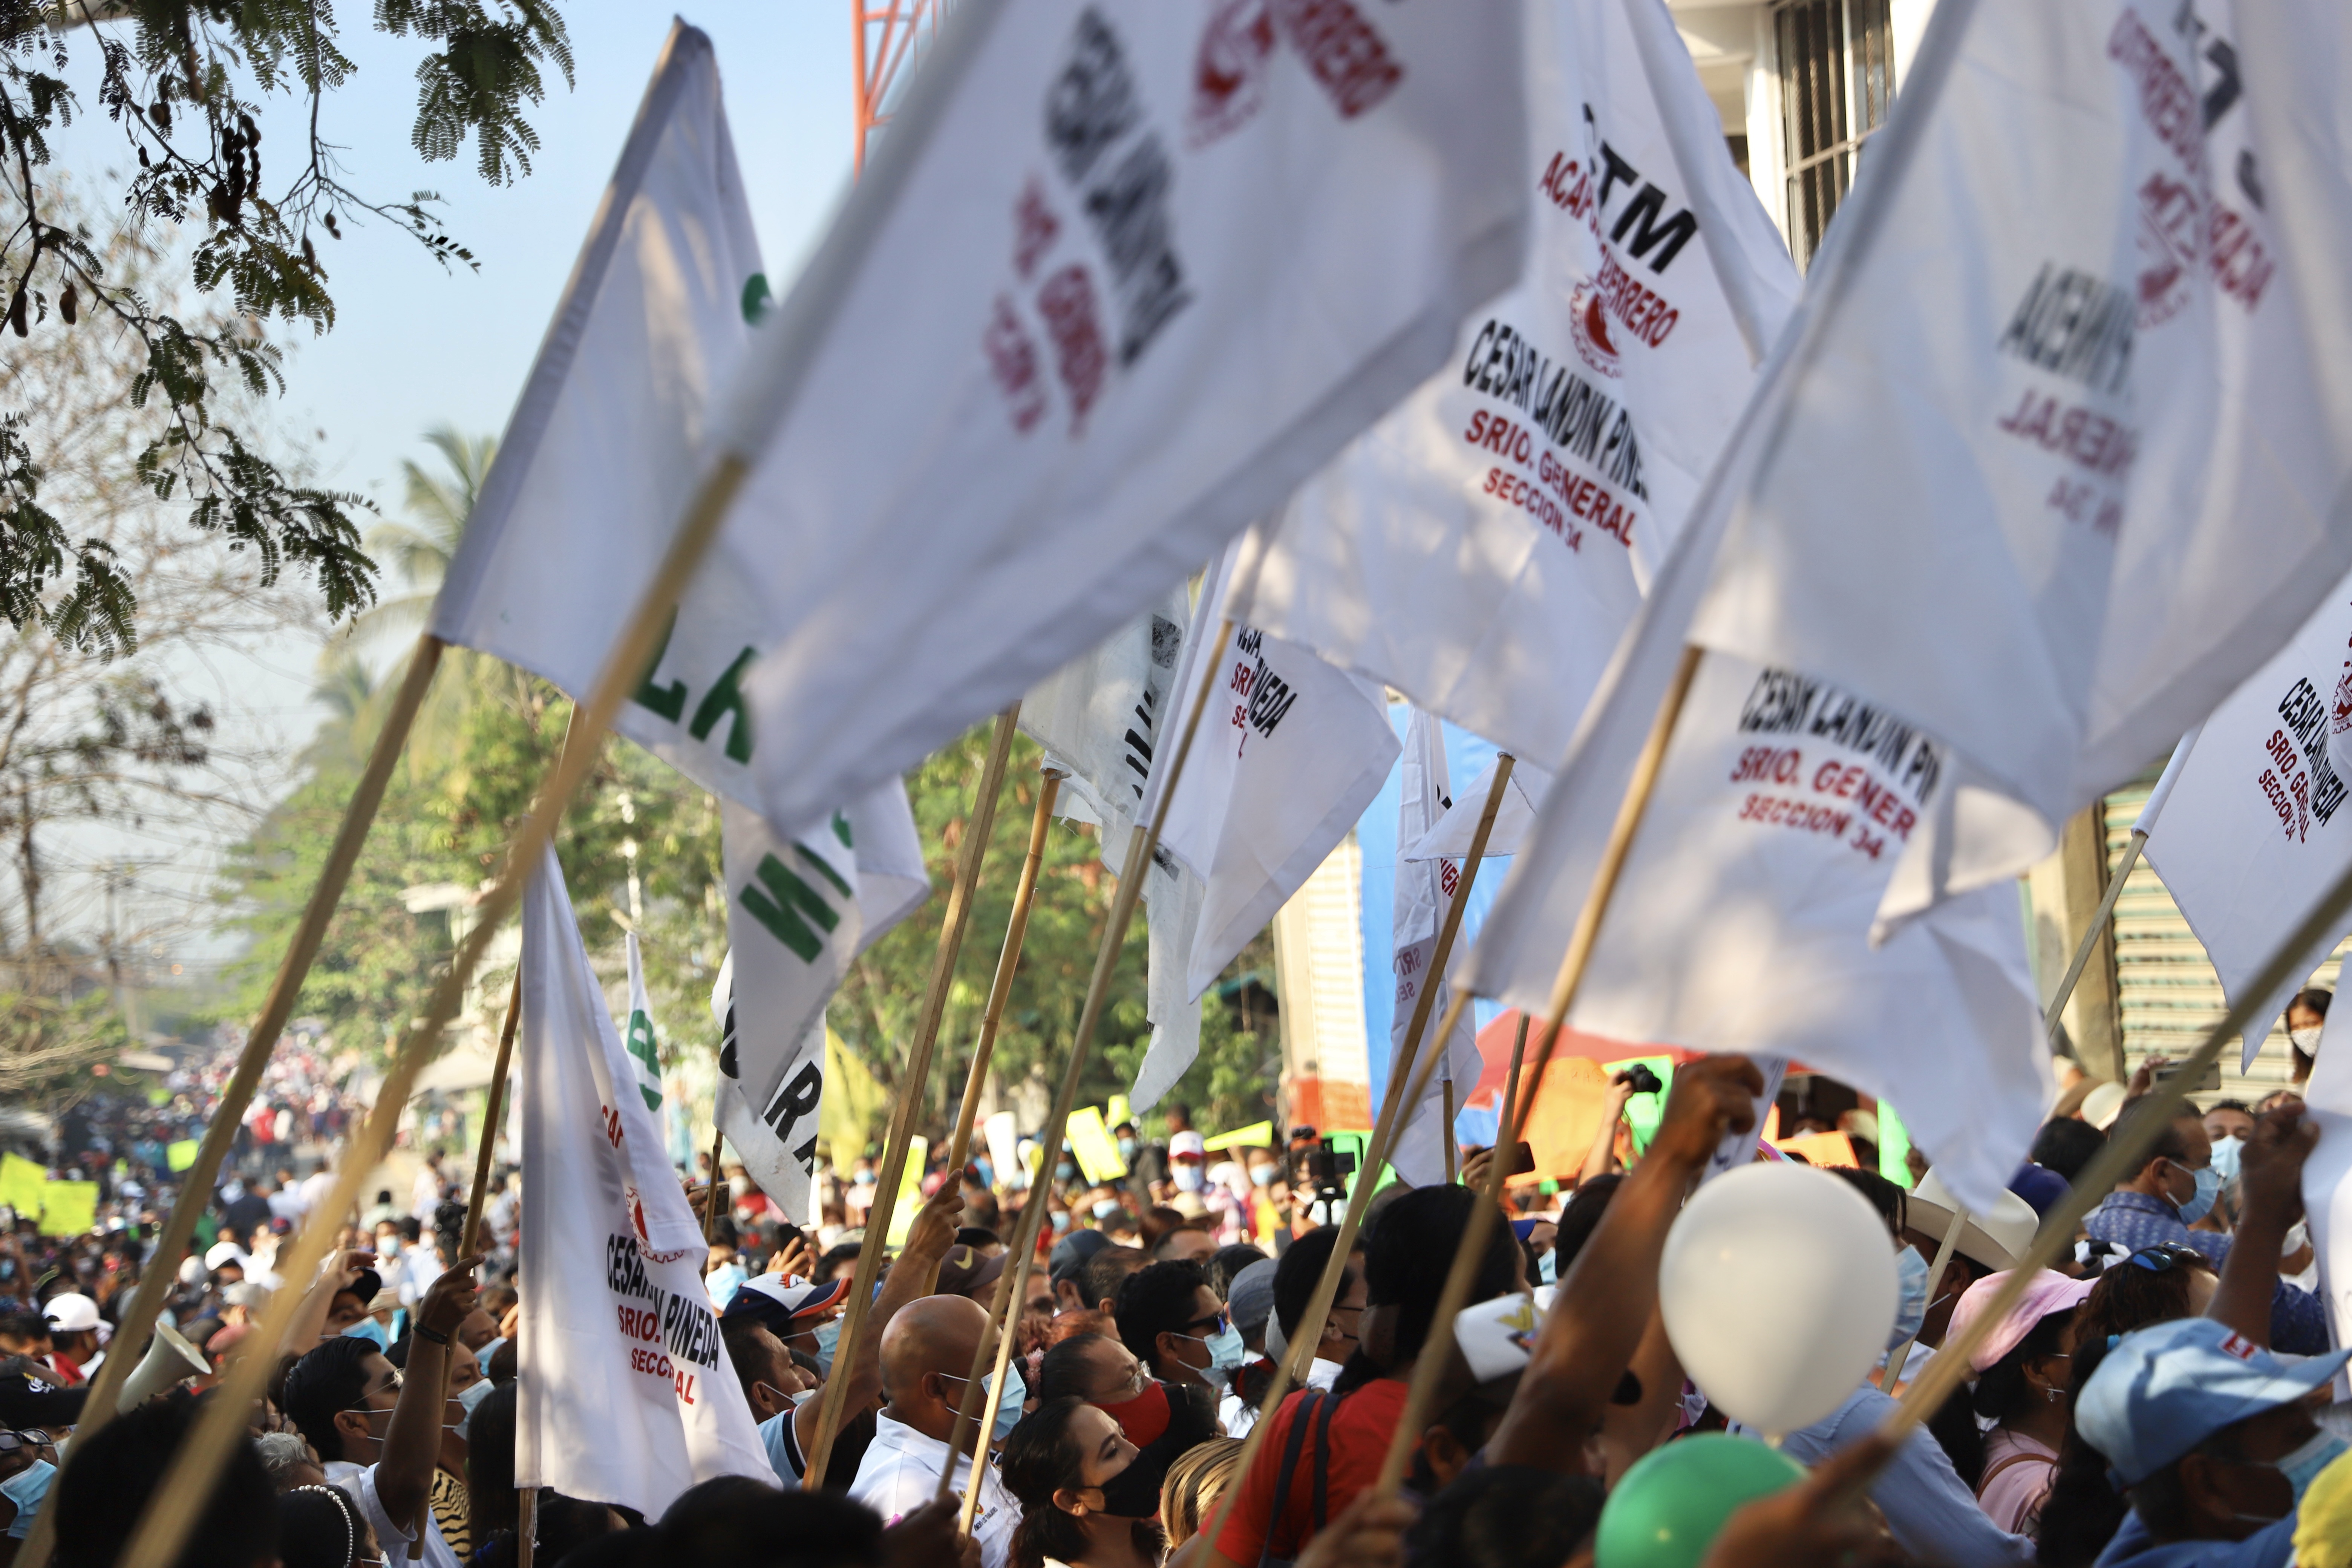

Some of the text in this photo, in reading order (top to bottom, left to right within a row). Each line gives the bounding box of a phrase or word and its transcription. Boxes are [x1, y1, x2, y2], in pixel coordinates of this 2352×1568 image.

[1582, 103, 1698, 276] TM
[1537, 150, 1600, 237] ACAP
[1596, 242, 1678, 349] UERRERO
[1463, 319, 1536, 414] CESAR
[1597, 407, 1649, 505] PINE
[1464, 409, 1637, 548] SRIO. GENERAL
[1483, 467, 1582, 553] SECCION 34
[1246, 656, 1297, 739] PINEDA
[2278, 677, 2324, 745] CESAR
[2266, 729, 2297, 780] SRIO.
[1738, 792, 1885, 860] SECCION 34
[2259, 769, 2294, 826] SECCION
[618, 1305, 660, 1343] SRIO.
[664, 1293, 719, 1372] PINEDA
